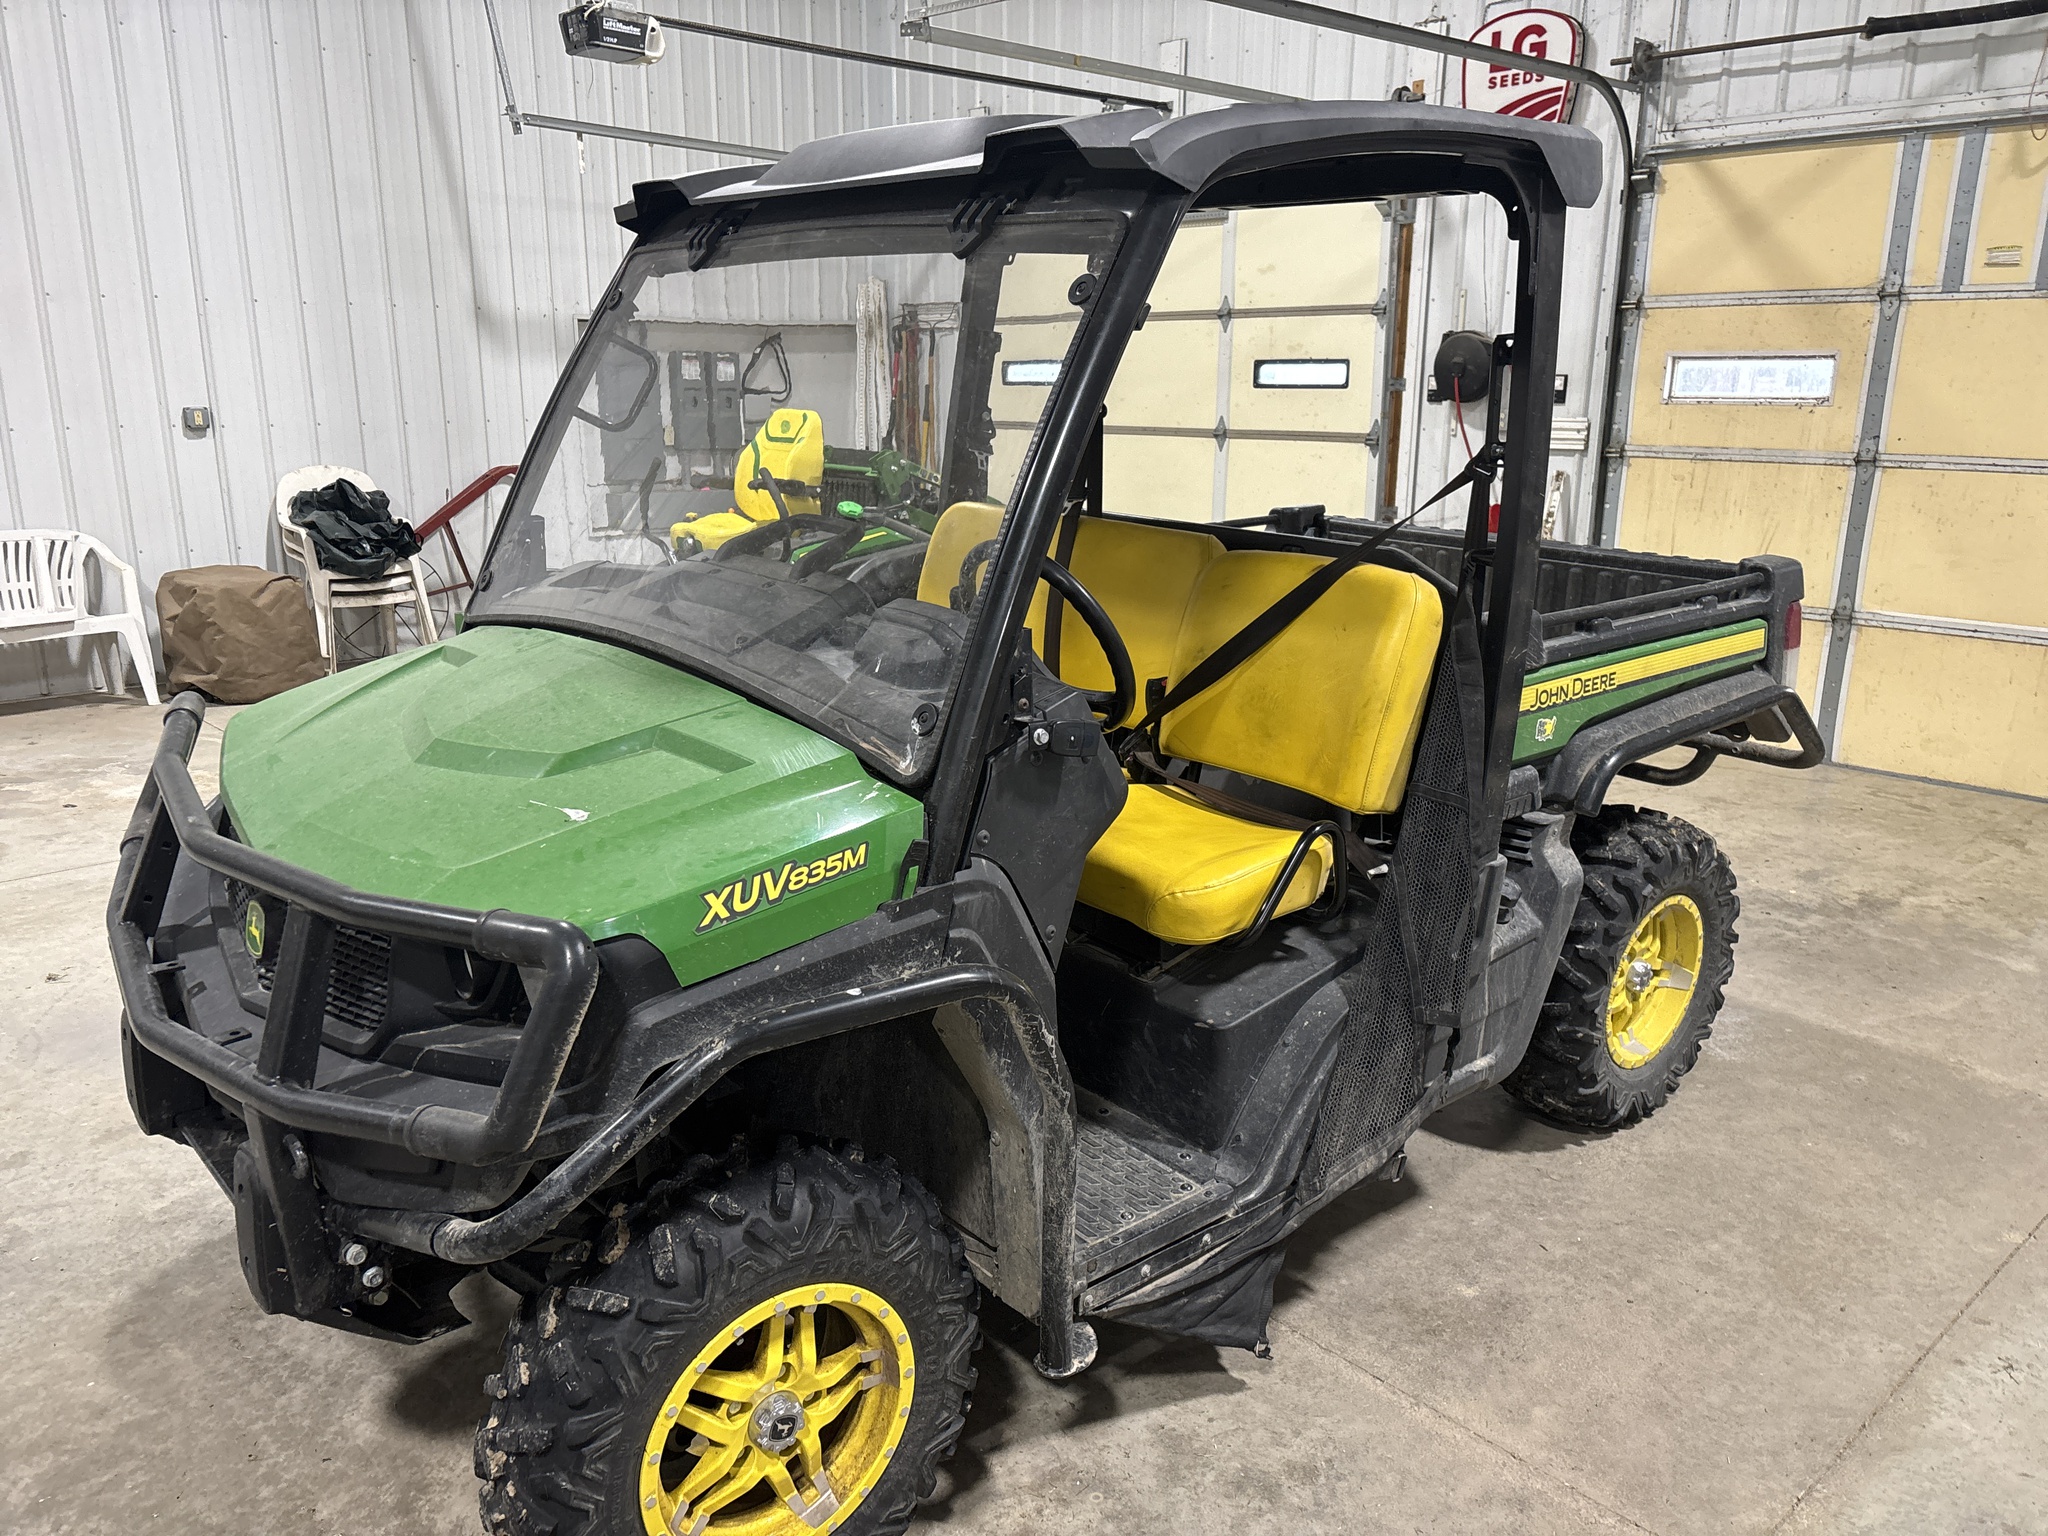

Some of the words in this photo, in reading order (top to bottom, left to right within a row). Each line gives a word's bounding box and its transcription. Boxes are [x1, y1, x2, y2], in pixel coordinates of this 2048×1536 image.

[1489, 24, 1547, 73] LG
[1488, 72, 1544, 89] SEEDS
[1530, 685, 1569, 709] JOHN
[1572, 672, 1617, 699] DEERE
[697, 842, 868, 930] XUV835M
